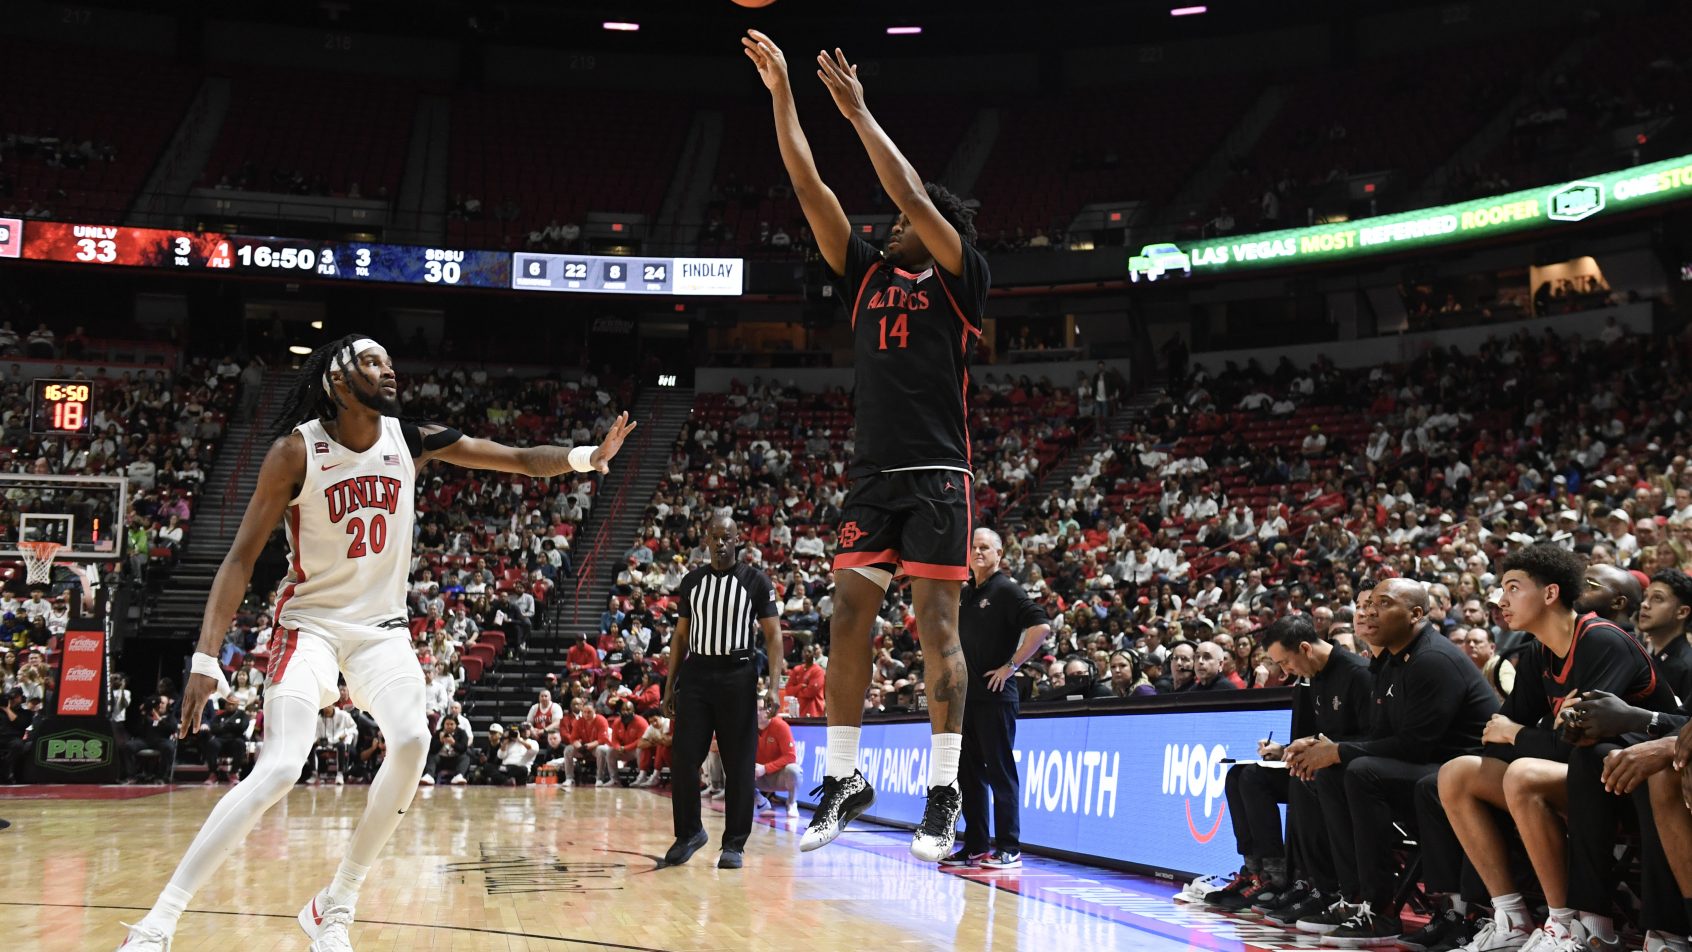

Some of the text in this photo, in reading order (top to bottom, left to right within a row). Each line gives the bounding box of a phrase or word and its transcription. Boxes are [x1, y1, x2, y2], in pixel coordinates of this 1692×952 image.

[61, 8, 92, 24] 217
[323, 33, 352, 50] 218
[568, 55, 596, 70] 219
[73, 225, 118, 239] UNLV
[1192, 199, 1540, 266] LAS VEGAS MOST REFERRED ROOFER
[76, 238, 117, 263] 33
[174, 237, 191, 256] 3
[218, 243, 229, 257] 1
[212, 258, 231, 268] FLS
[237, 245, 315, 270] 16:50
[321, 249, 334, 264] 3
[355, 248, 372, 267] 3
[425, 248, 465, 262] SDSU
[317, 264, 336, 275] FLS
[355, 267, 370, 276] TOL
[424, 261, 461, 284] 30
[529, 262, 541, 276] 6
[565, 263, 587, 278] 22
[609, 265, 621, 279] 8
[644, 266, 666, 280] 24
[682, 263, 733, 278] FINDLAY
[878, 313, 910, 350] 14
[45, 384, 89, 402] 16:50
[54, 401, 83, 430] 18
[324, 475, 401, 524] UNLV
[346, 513, 387, 559] 20
[47, 739, 103, 759] PRS
[1024, 749, 1120, 818] MONTH
